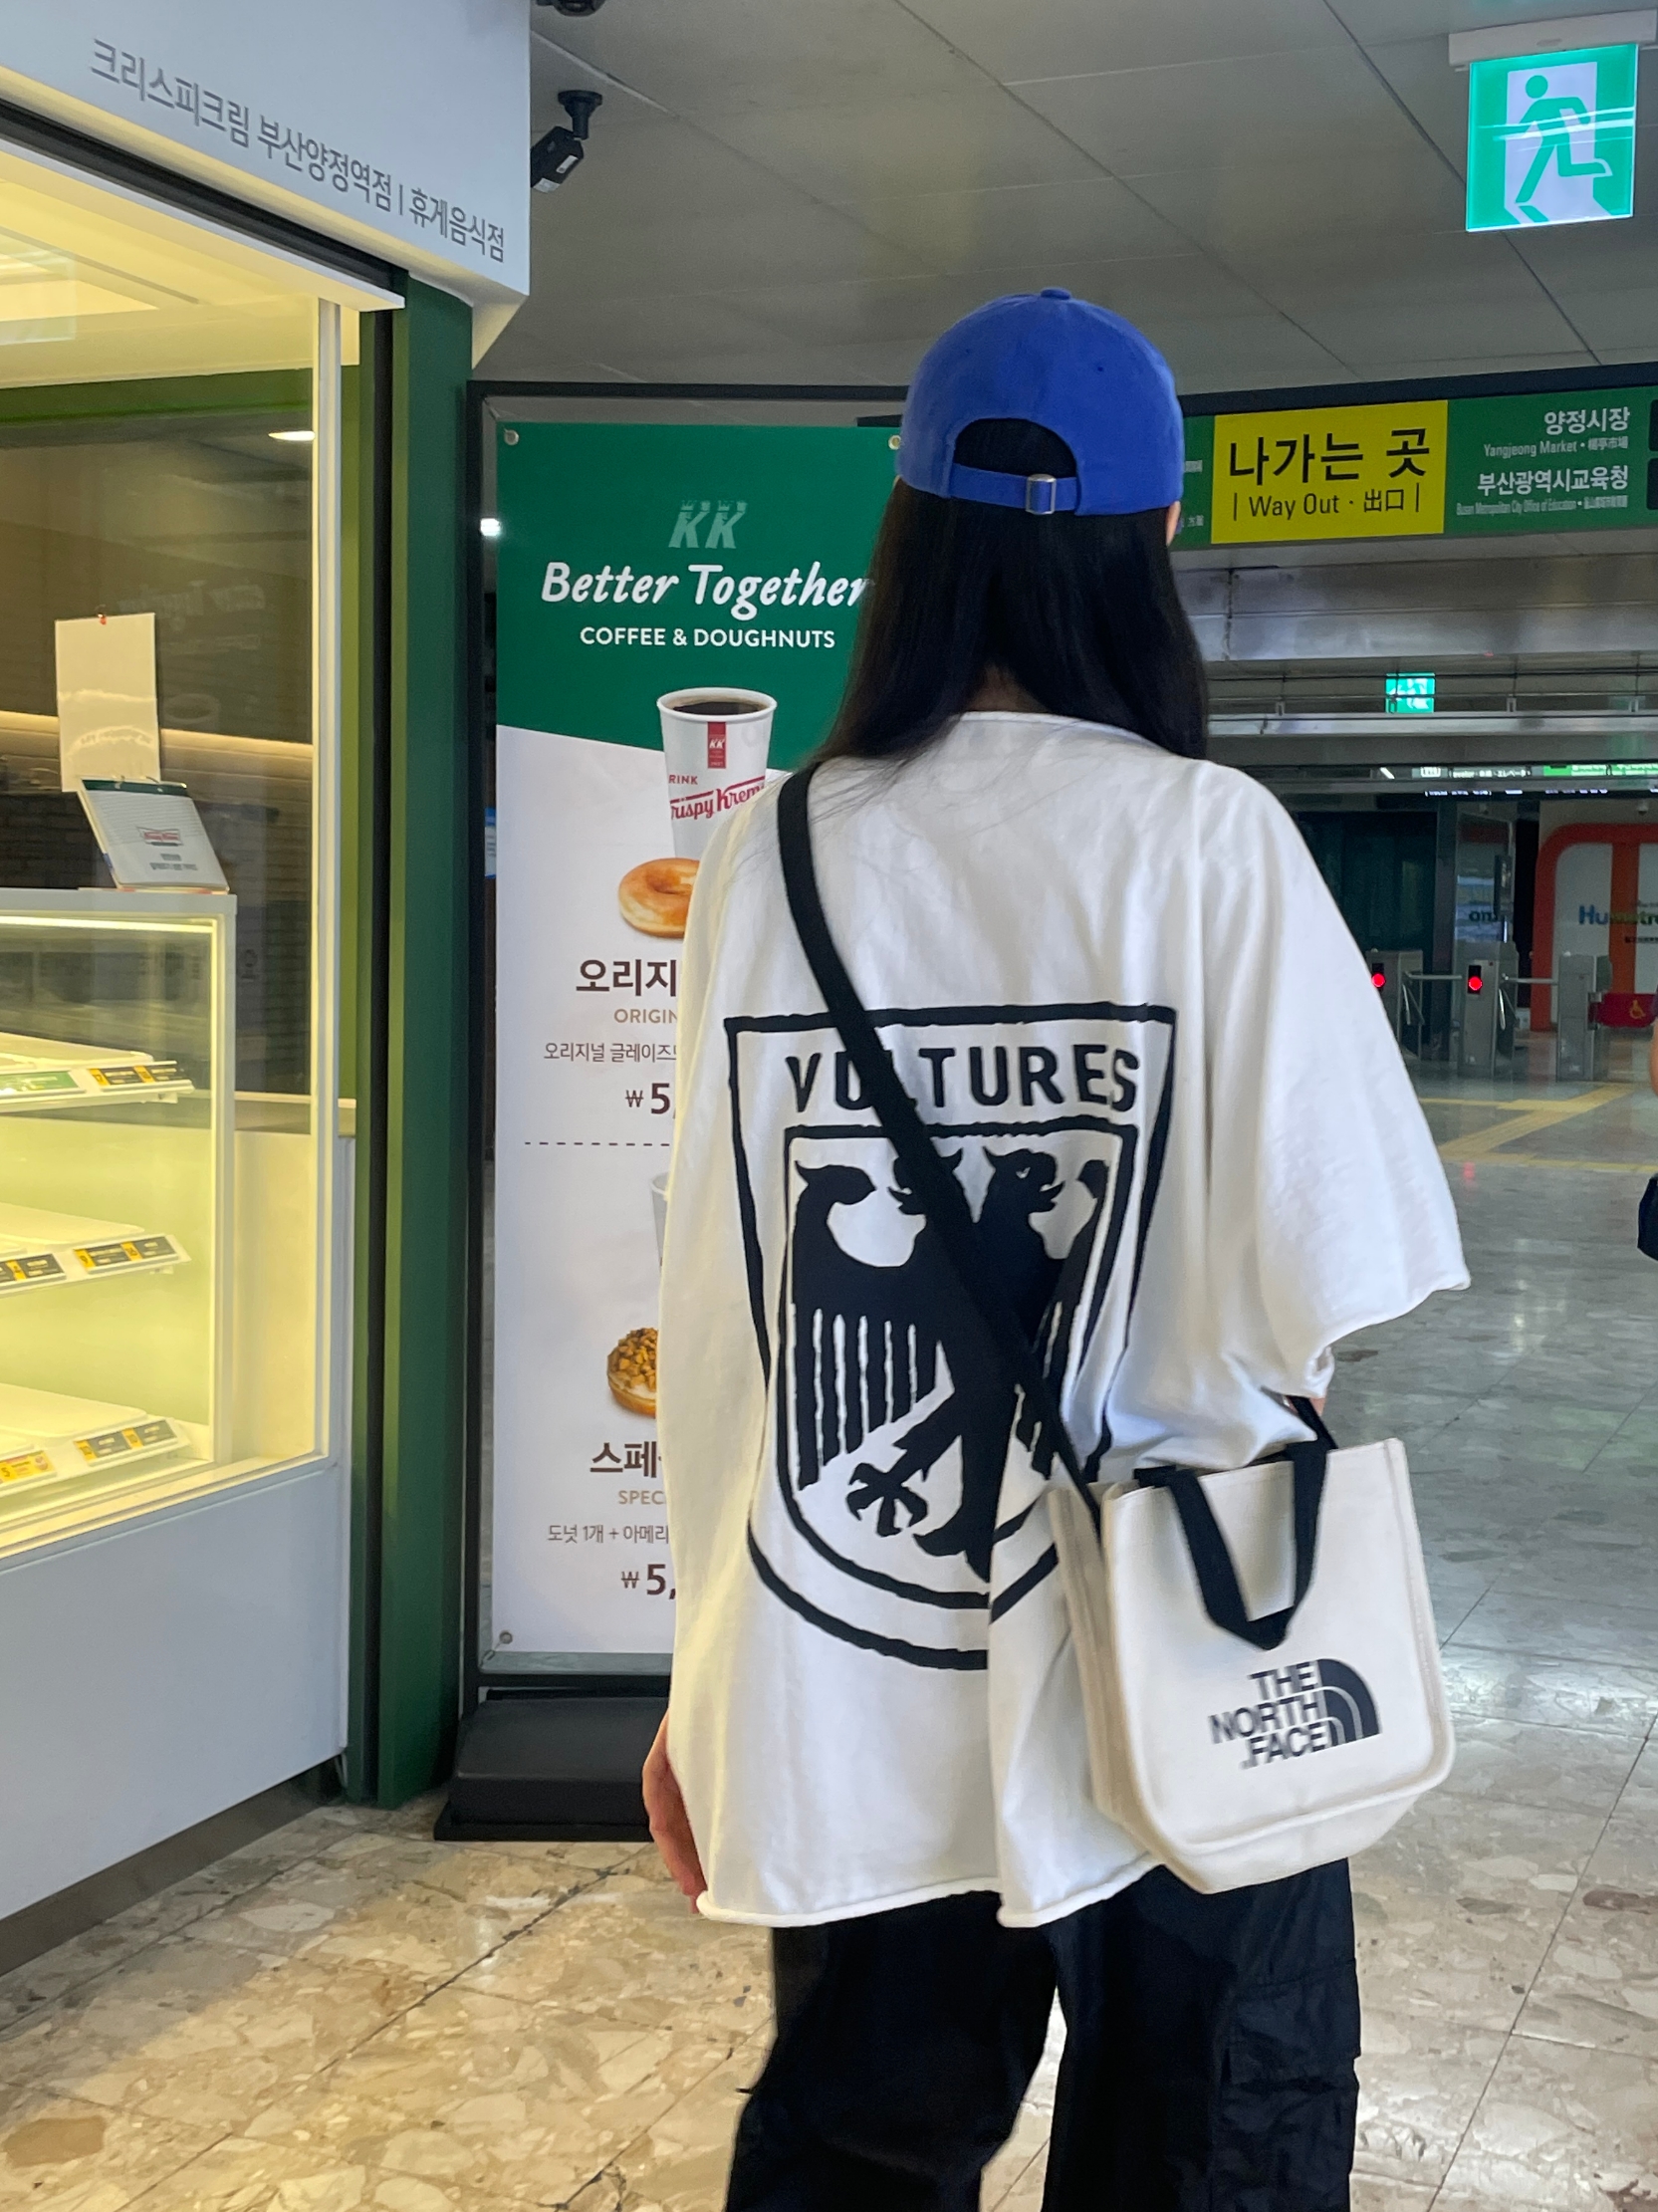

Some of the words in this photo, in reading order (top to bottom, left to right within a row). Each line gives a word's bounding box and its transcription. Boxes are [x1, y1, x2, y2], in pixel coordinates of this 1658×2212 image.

[92, 38, 250, 148] 크리스피크림
[257, 115, 392, 213] 부산양정역점
[408, 186, 505, 263] 휴게음식점
[1543, 406, 1630, 435] 양정시장
[1230, 432, 1363, 486] 나가는
[1386, 428, 1430, 479] 곳
[1484, 443, 1537, 459] Yangjeong
[1540, 440, 1577, 454] Market
[1477, 465, 1629, 496] 부산광역시교육청
[1249, 495, 1296, 521] Way
[1303, 493, 1339, 515] Out
[1363, 489, 1404, 513] 出口
[668, 500, 748, 549] KK
[541, 561, 679, 605] Better
[687, 561, 874, 621] Together
[580, 626, 666, 646] COFFEE
[671, 627, 688, 647] &
[694, 628, 835, 648] DOUGHNUTS
[716, 777, 766, 812] Krem
[576, 959, 677, 997] 오리지
[544, 1042, 605, 1062] 오리지널
[609, 1043, 677, 1063] 글레이즈
[785, 1044, 1140, 1113] VUTURES
[590, 1441, 662, 1478] 스페
[548, 1524, 579, 1544] 도넛
[583, 1525, 603, 1544] 1개
[1248, 1660, 1316, 1701] THE
[1208, 1691, 1326, 1745] NORTH
[1241, 1721, 1327, 1770] FACE
